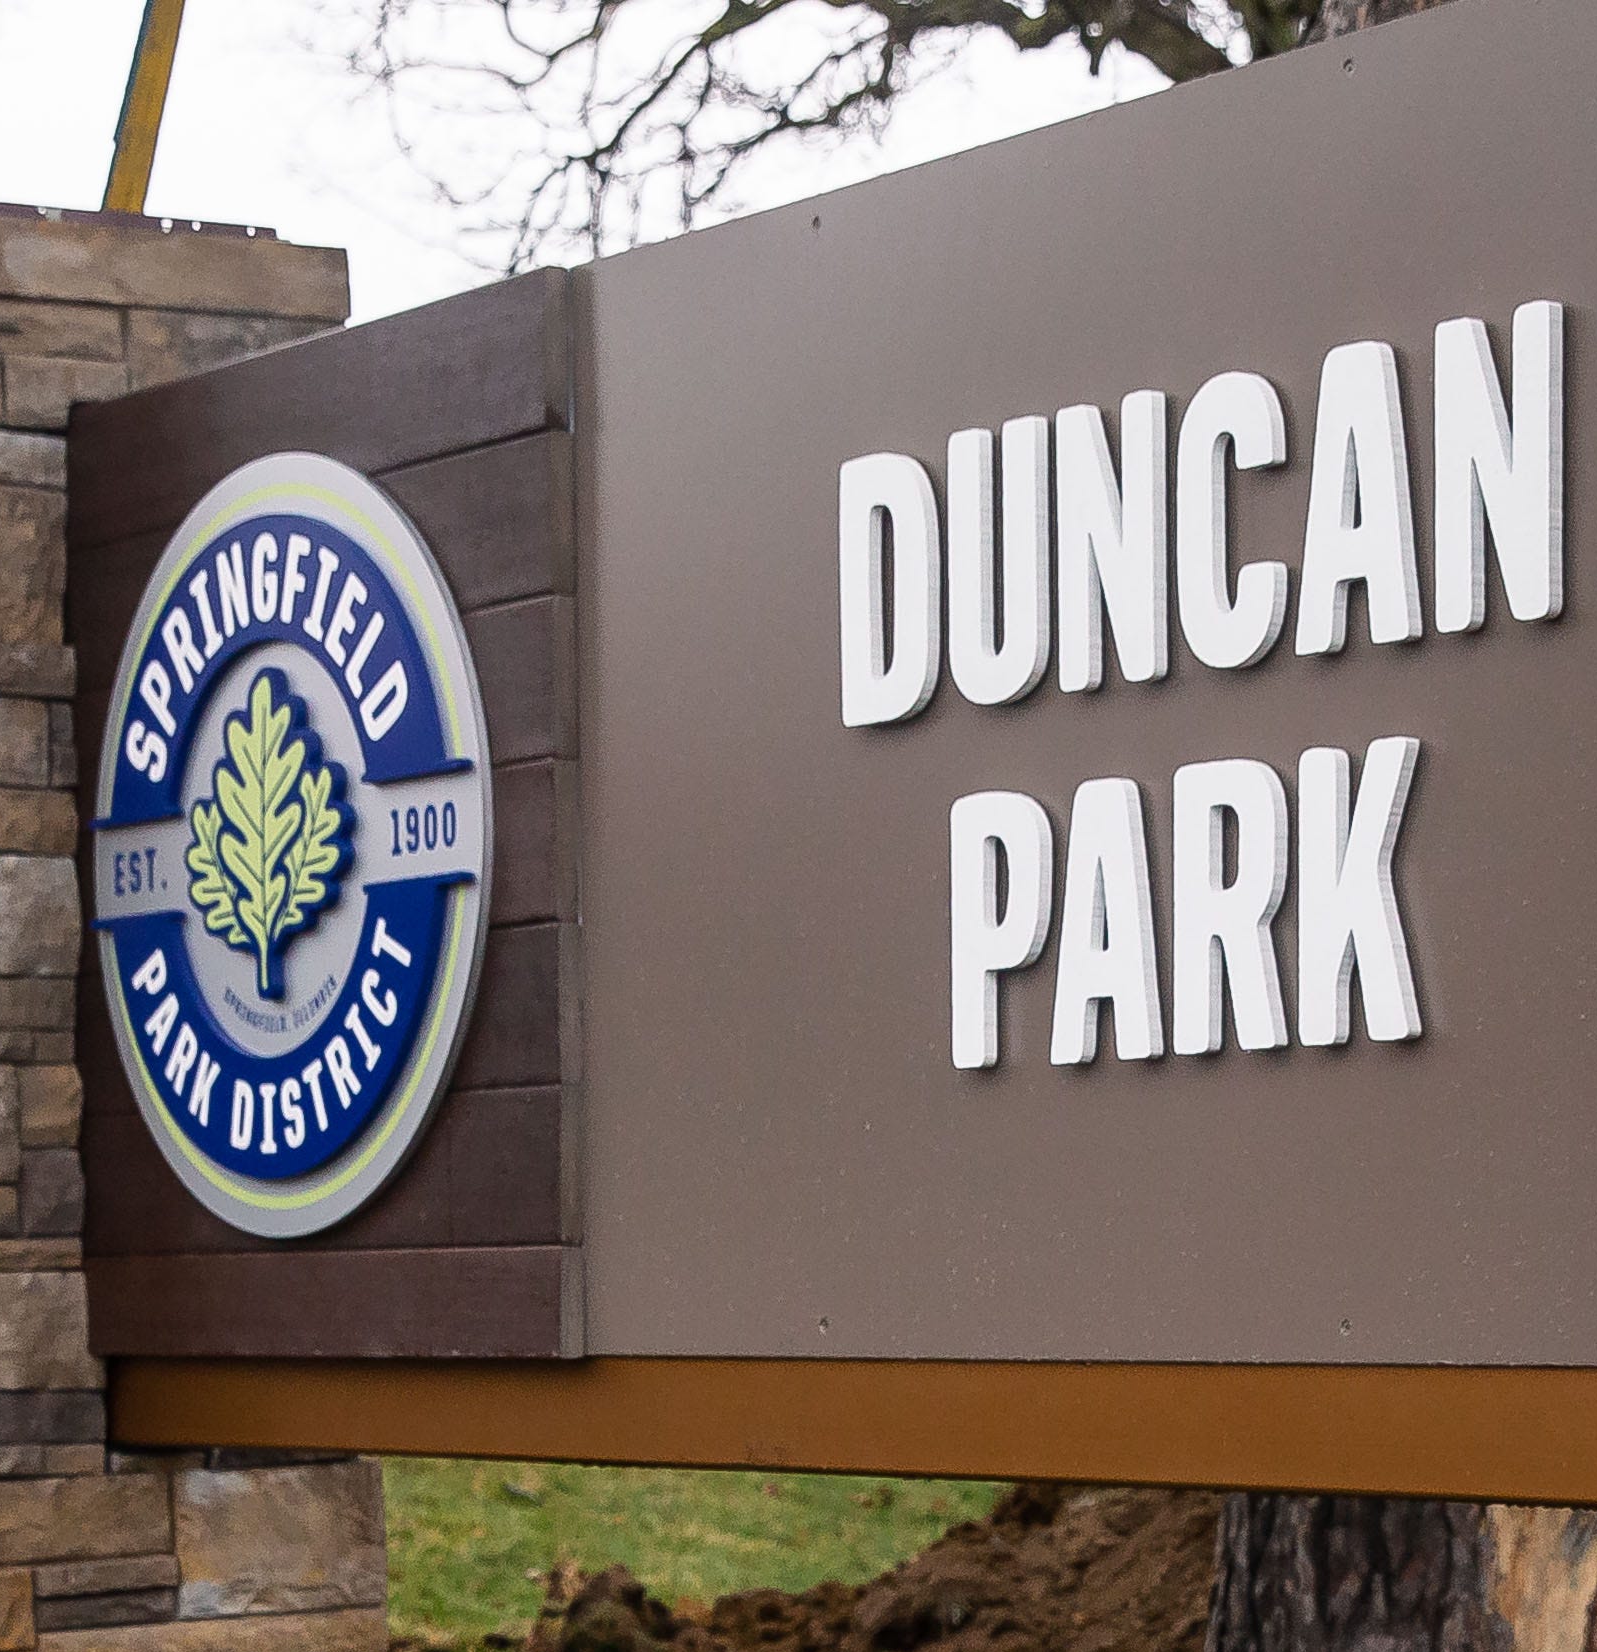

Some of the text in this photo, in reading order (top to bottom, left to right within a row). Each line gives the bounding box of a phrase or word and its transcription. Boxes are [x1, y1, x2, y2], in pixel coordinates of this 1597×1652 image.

[839, 299, 1564, 727] DUNCAN
[125, 532, 408, 783] SPRINGFIELD
[113, 801, 458, 896] EST. 1900
[950, 736, 1422, 1069] PARK
[130, 916, 412, 1154] PARK DISTRICT
